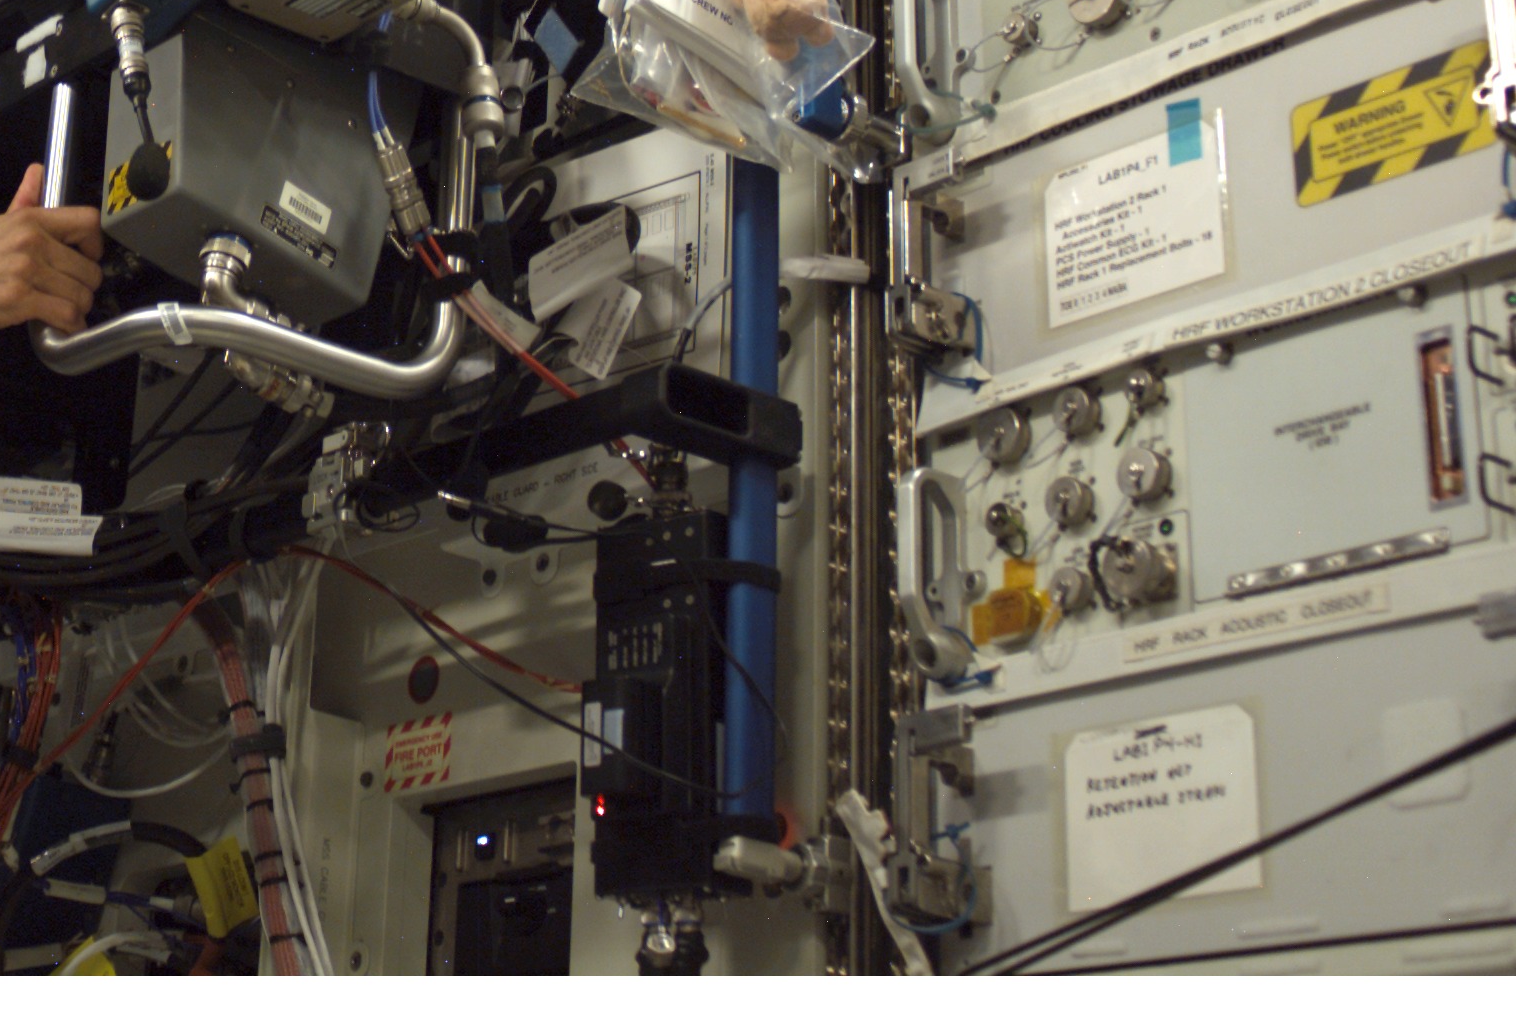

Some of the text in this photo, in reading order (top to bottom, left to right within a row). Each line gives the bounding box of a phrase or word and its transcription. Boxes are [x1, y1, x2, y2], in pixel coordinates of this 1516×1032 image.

[1333, 99, 1406, 134] WARNING
[1098, 154, 1159, 185] LAB1P4_F1
[1054, 217, 1073, 231] HRF
[1137, 188, 1159, 201] Rack
[1117, 210, 1130, 221] Kit
[1056, 254, 1075, 267] PCS
[1076, 244, 1103, 260] Power
[1106, 234, 1137, 251] Supply
[1100, 228, 1112, 239] Kit
[1056, 266, 1075, 279] HRF
[1076, 253, 1117, 272] Common
[1118, 244, 1139, 258] ECG
[1141, 238, 1154, 249] Kit
[1056, 277, 1075, 291] HRF
[1077, 270, 1099, 283] Rack
[1108, 247, 1167, 273] Replacement
[1172, 320, 1212, 341] HRF
[1214, 283, 1351, 331] WORKSTATION
[1354, 276, 1366, 293] 2
[1371, 241, 1472, 288] CLOSEOUT
[1274, 402, 1370, 436] INTERCHANGEABLE
[1172, 626, 1208, 645] RACK
[1220, 609, 1288, 635] ACOUSTIC
[1300, 589, 1372, 619] CLOSEOUT
[394, 742, 442, 761] FIRE PORT
